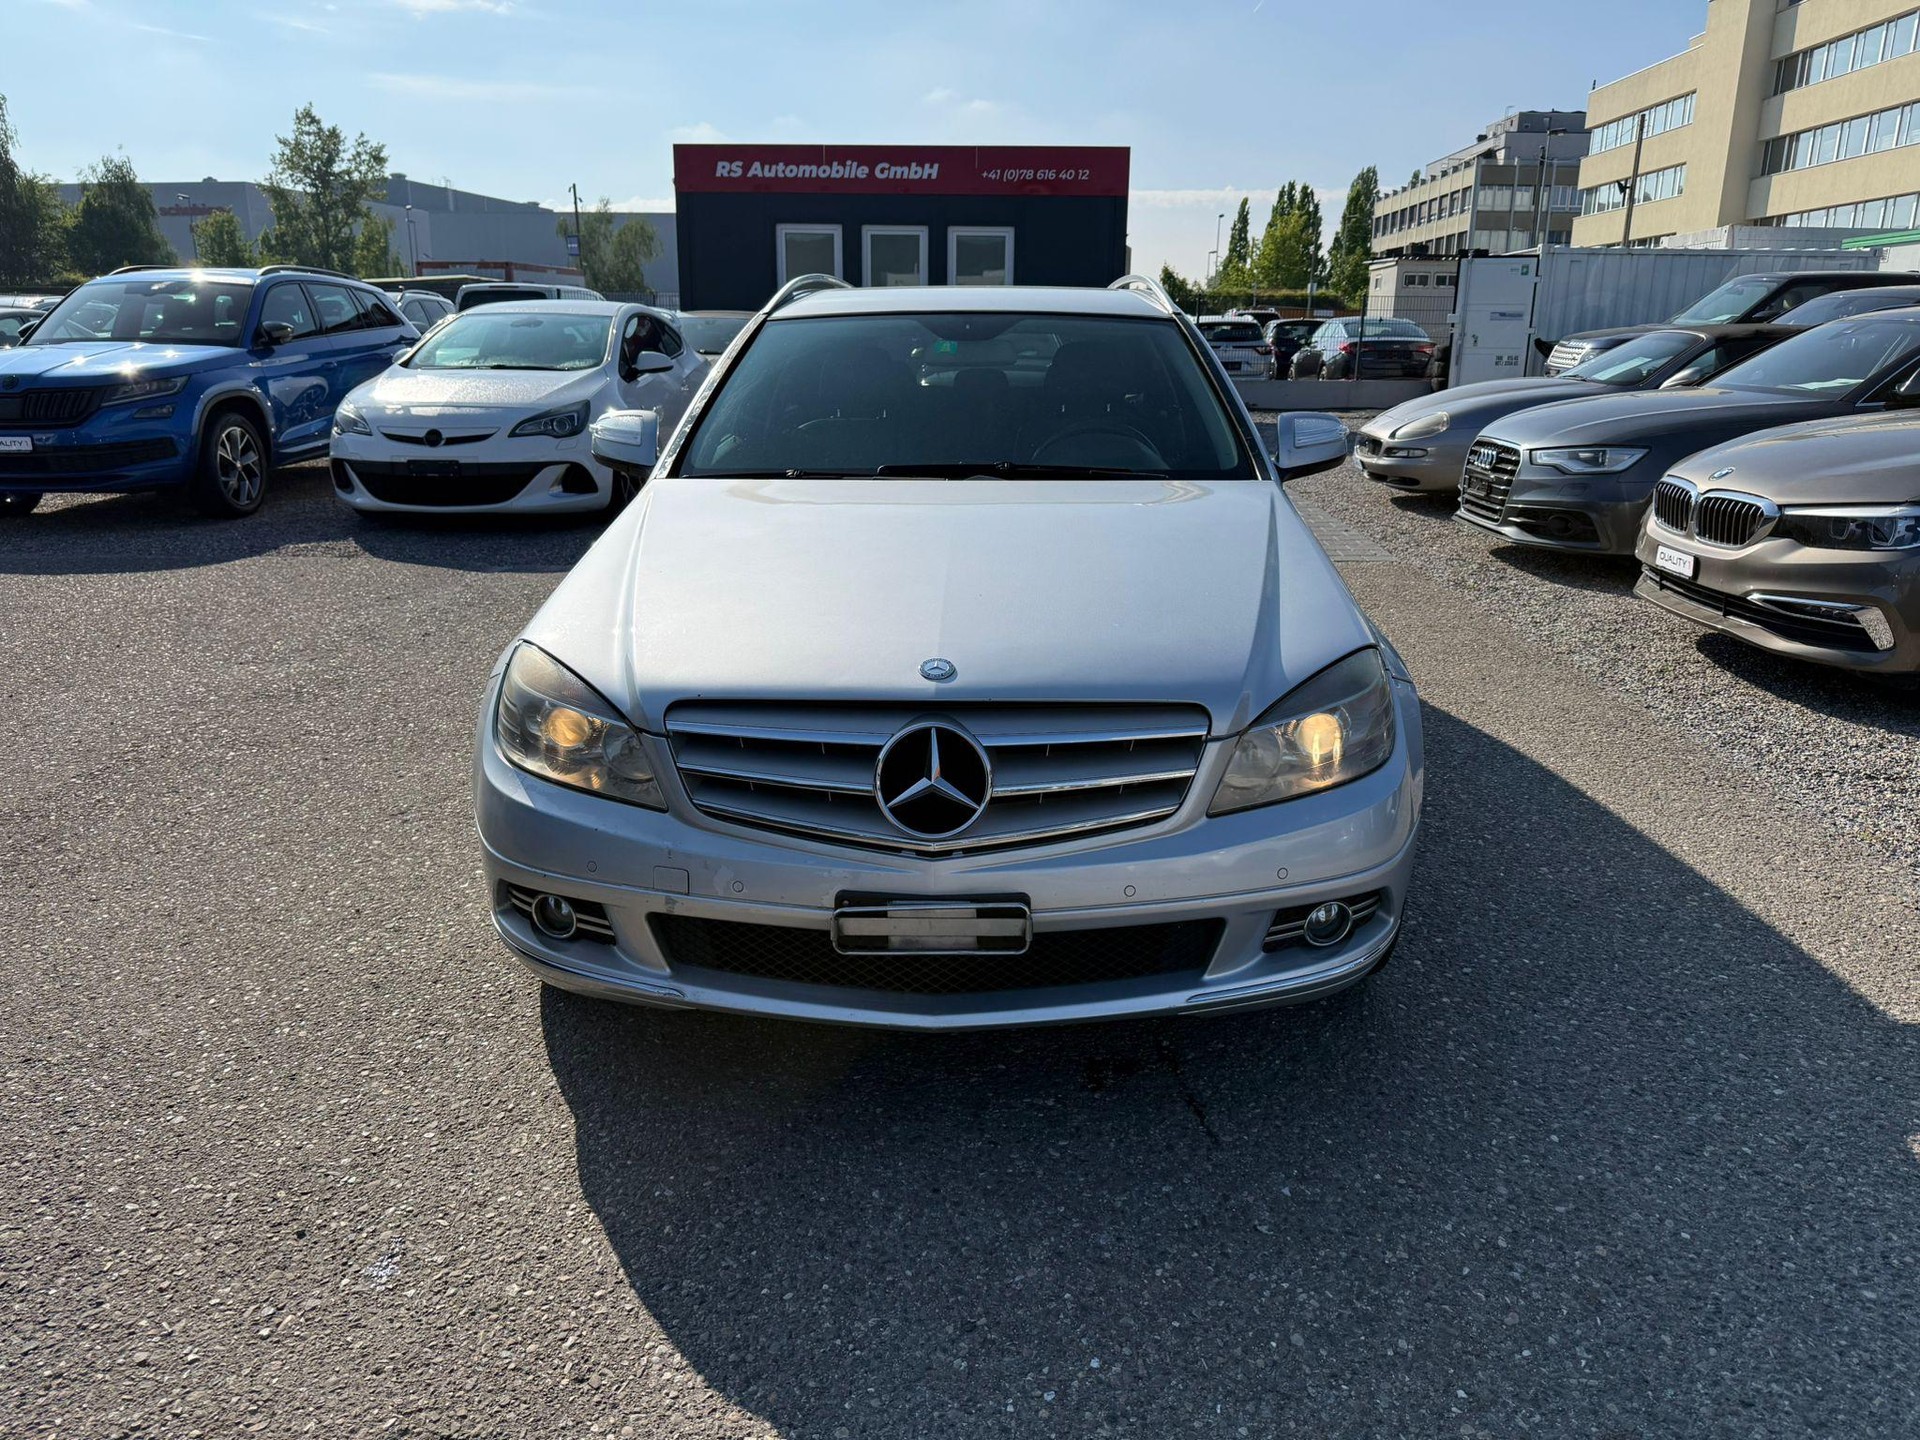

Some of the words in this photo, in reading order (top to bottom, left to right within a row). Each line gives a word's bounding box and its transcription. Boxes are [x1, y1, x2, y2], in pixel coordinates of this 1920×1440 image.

[715, 160, 743, 178] RS
[747, 160, 869, 178] Automobile
[874, 162, 939, 179] GmbH
[982, 169, 1001, 180] +41
[1003, 168, 1034, 182] (0)78
[1036, 169, 1056, 180] 616
[1059, 169, 1075, 180] 40
[1078, 169, 1090, 180] 12
[1660, 551, 1687, 568] QUALITY
